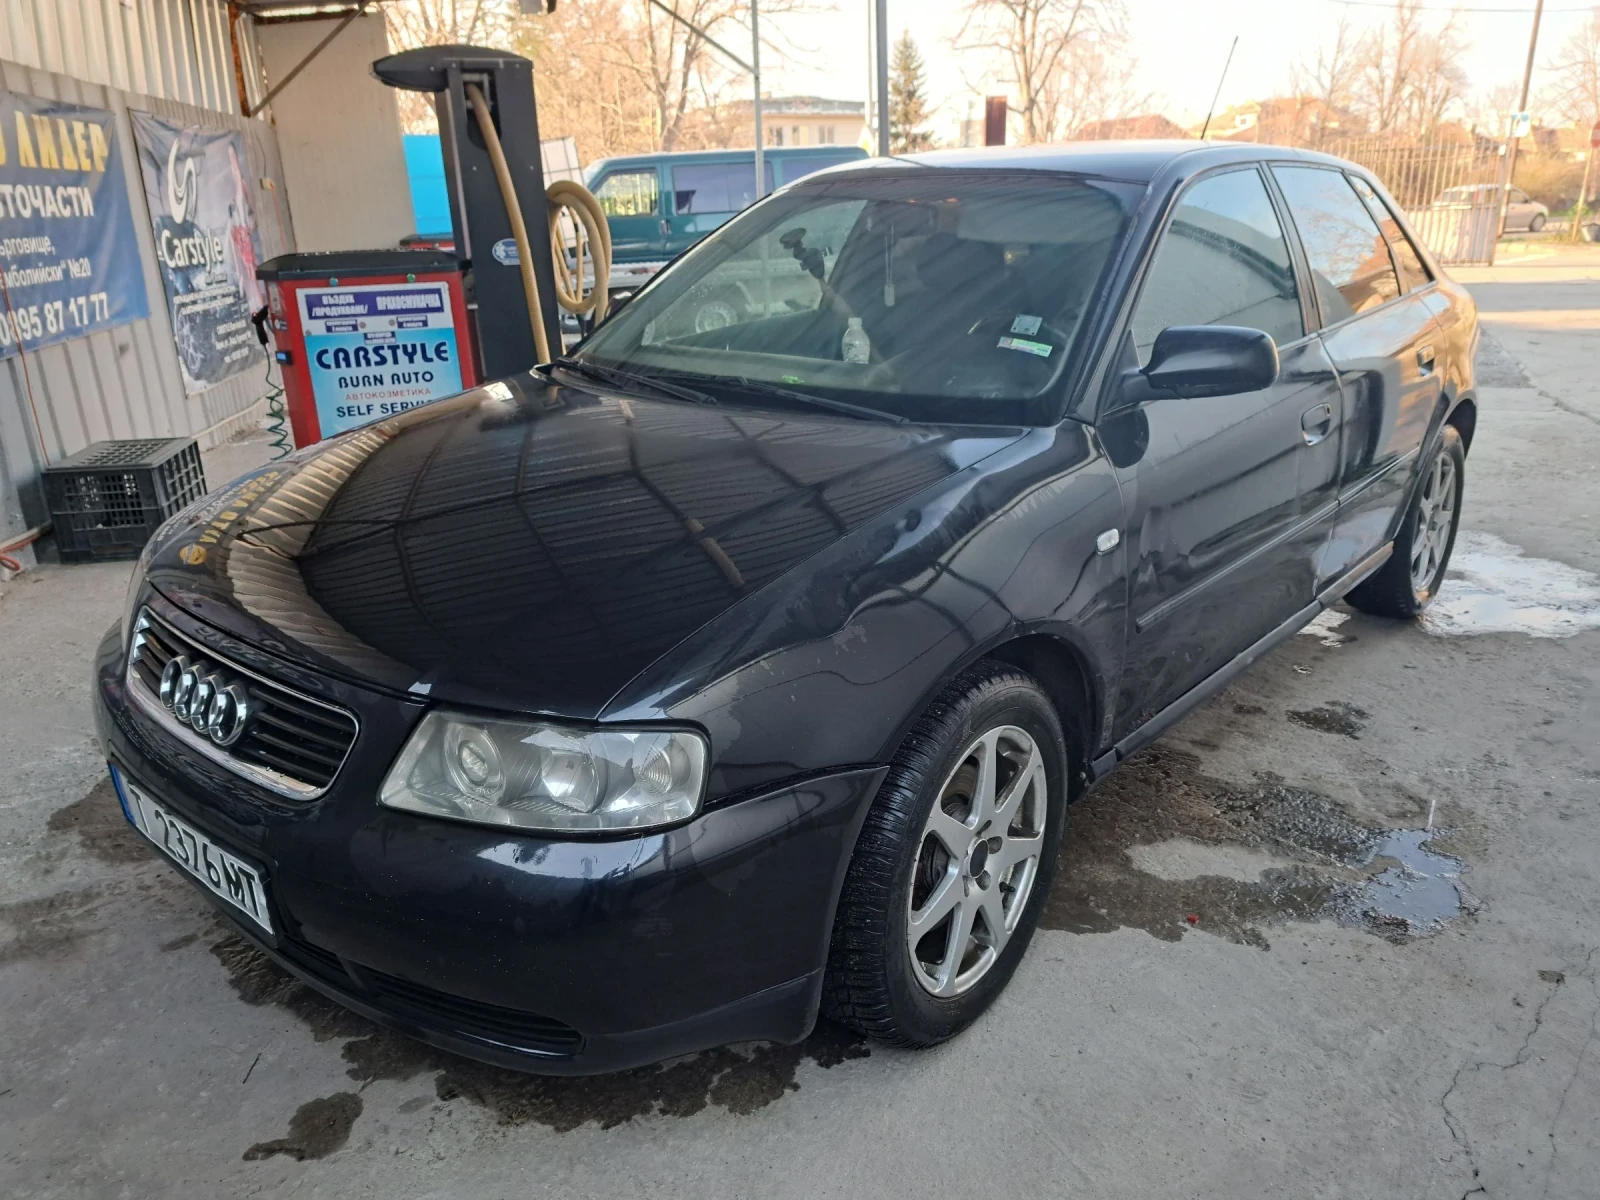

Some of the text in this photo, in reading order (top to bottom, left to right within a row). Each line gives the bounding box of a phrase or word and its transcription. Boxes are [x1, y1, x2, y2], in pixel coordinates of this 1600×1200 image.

[14, 109, 109, 172] ЛИДЕР
[161, 227, 223, 274] Carstyle
[44, 300, 64, 333] 87
[69, 296, 88, 327] 17
[90, 292, 109, 322] 77
[316, 341, 449, 370] CARSTYLE
[338, 371, 434, 389] BURN AUTO
[345, 388, 431, 401] АВТОКОЗМЕТИКА
[336, 400, 432, 418] SELF SERV
[154, 808, 222, 889] 2376
